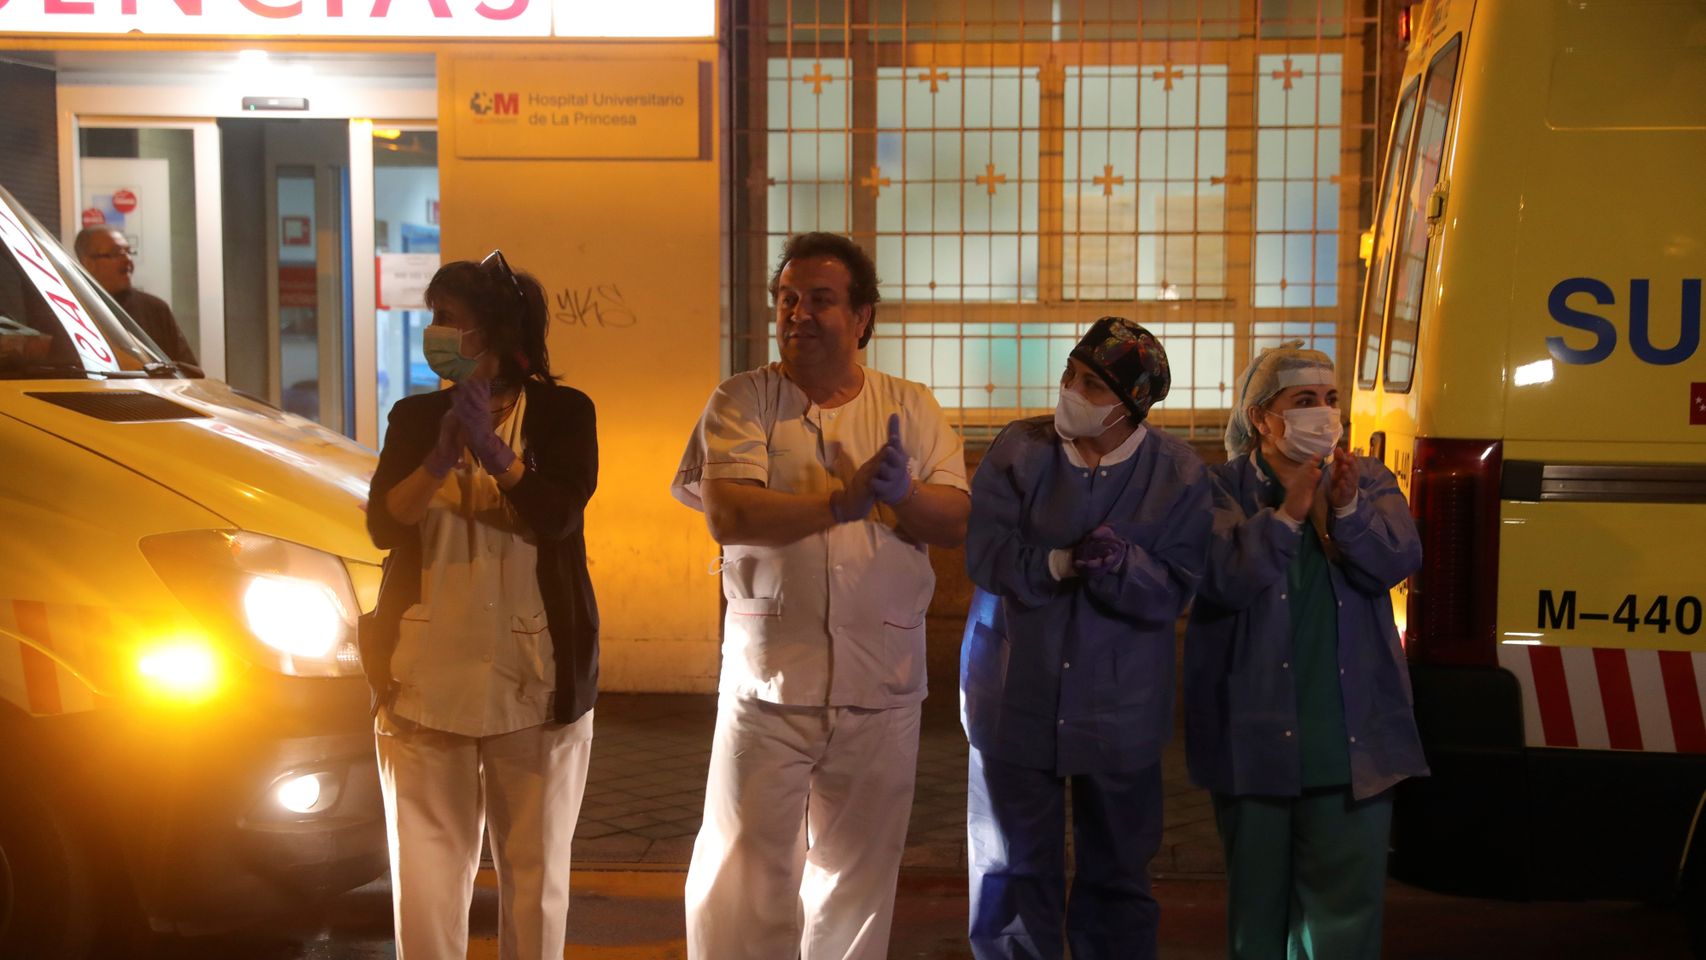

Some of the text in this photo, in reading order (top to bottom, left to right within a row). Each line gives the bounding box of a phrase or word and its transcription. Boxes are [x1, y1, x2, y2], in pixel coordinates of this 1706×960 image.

[528, 93, 684, 110] Hospital Universitario
[528, 112, 547, 126] de
[551, 112, 569, 126] La
[574, 112, 637, 126] Princesa
[1545, 277, 1702, 366] SU
